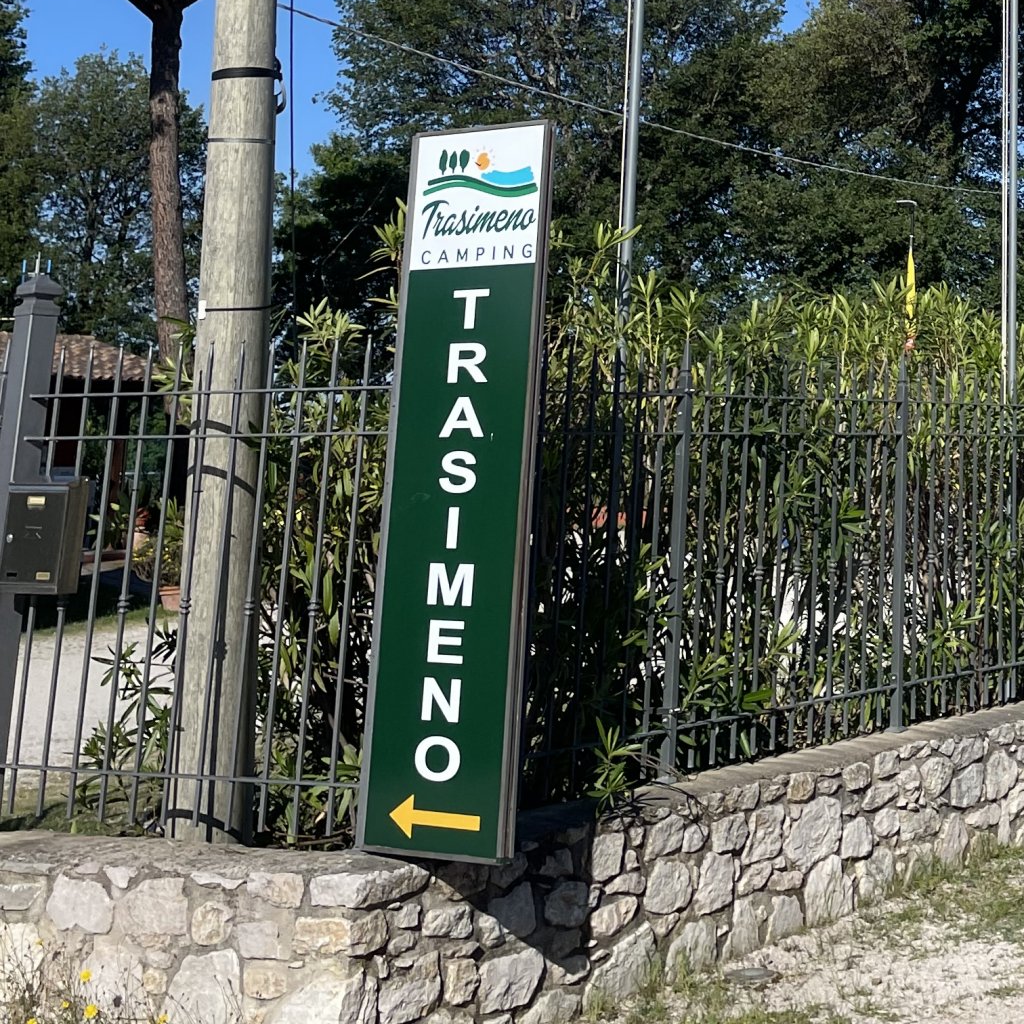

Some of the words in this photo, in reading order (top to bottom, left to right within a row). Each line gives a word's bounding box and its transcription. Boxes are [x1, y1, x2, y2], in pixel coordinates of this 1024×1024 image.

[421, 199, 537, 240] Trasimeno
[421, 243, 533, 265] CAMPING
[414, 288, 491, 782] TRASIMENO
